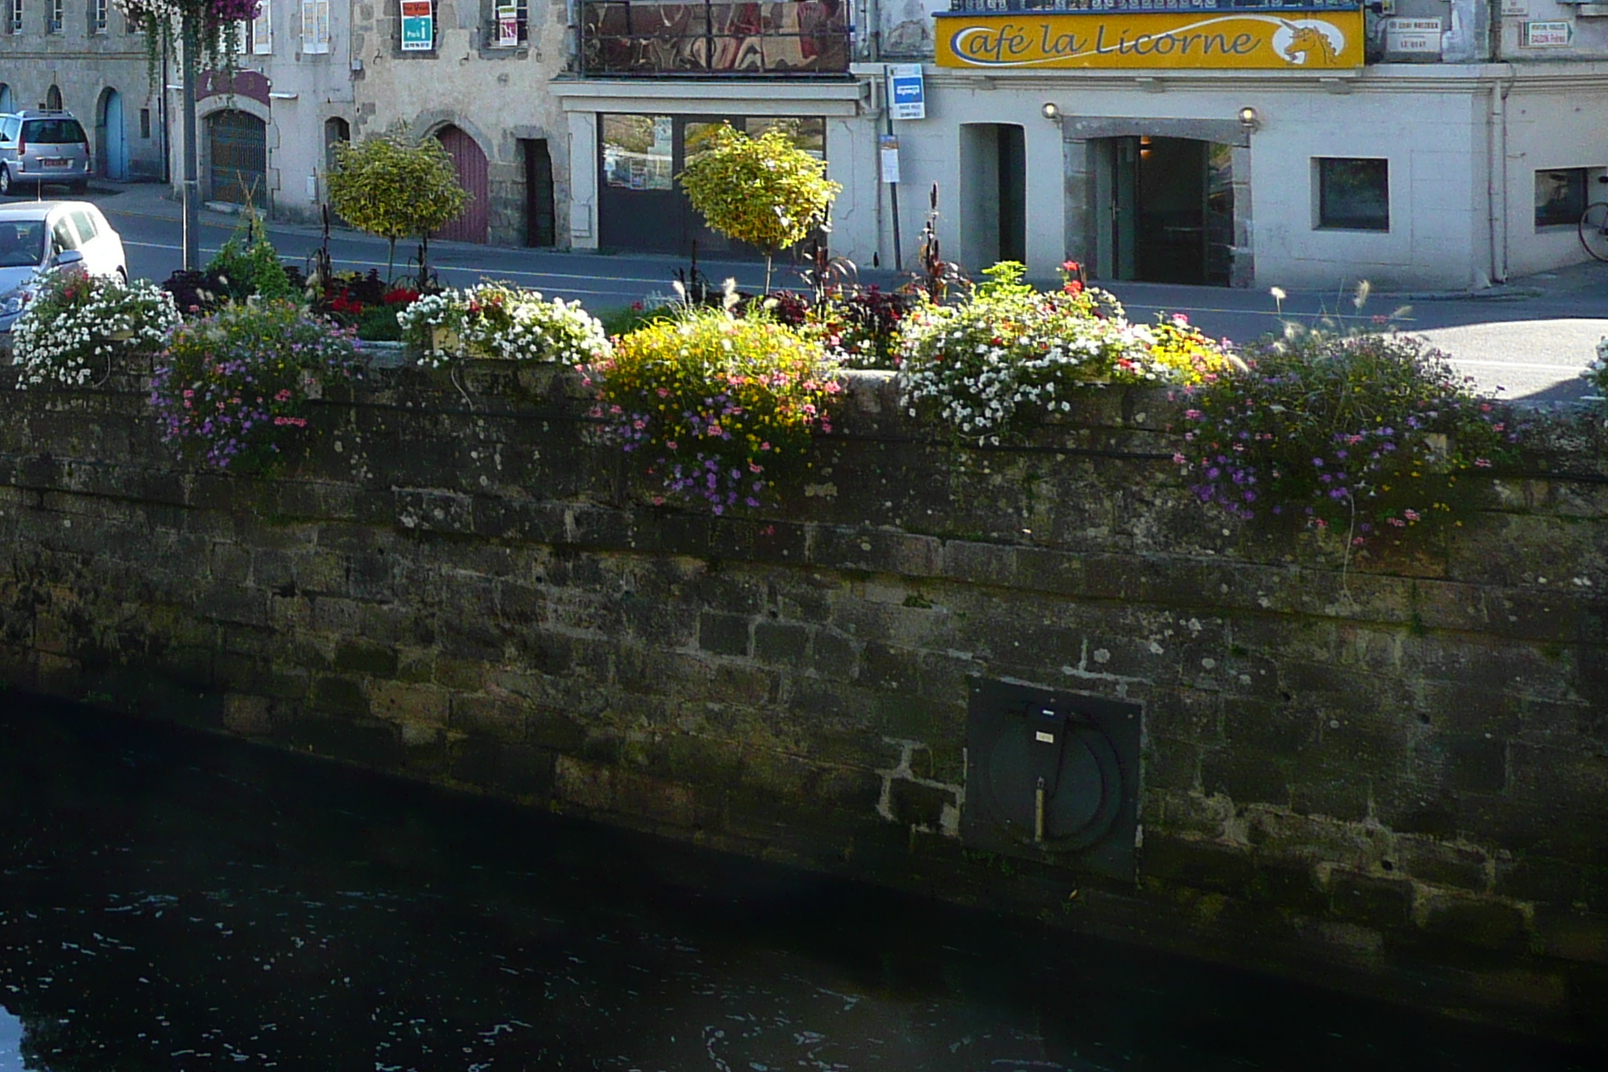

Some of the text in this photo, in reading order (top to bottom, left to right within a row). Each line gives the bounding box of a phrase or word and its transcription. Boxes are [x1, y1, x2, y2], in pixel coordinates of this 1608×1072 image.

[950, 24, 1260, 66] Café la Licorne
